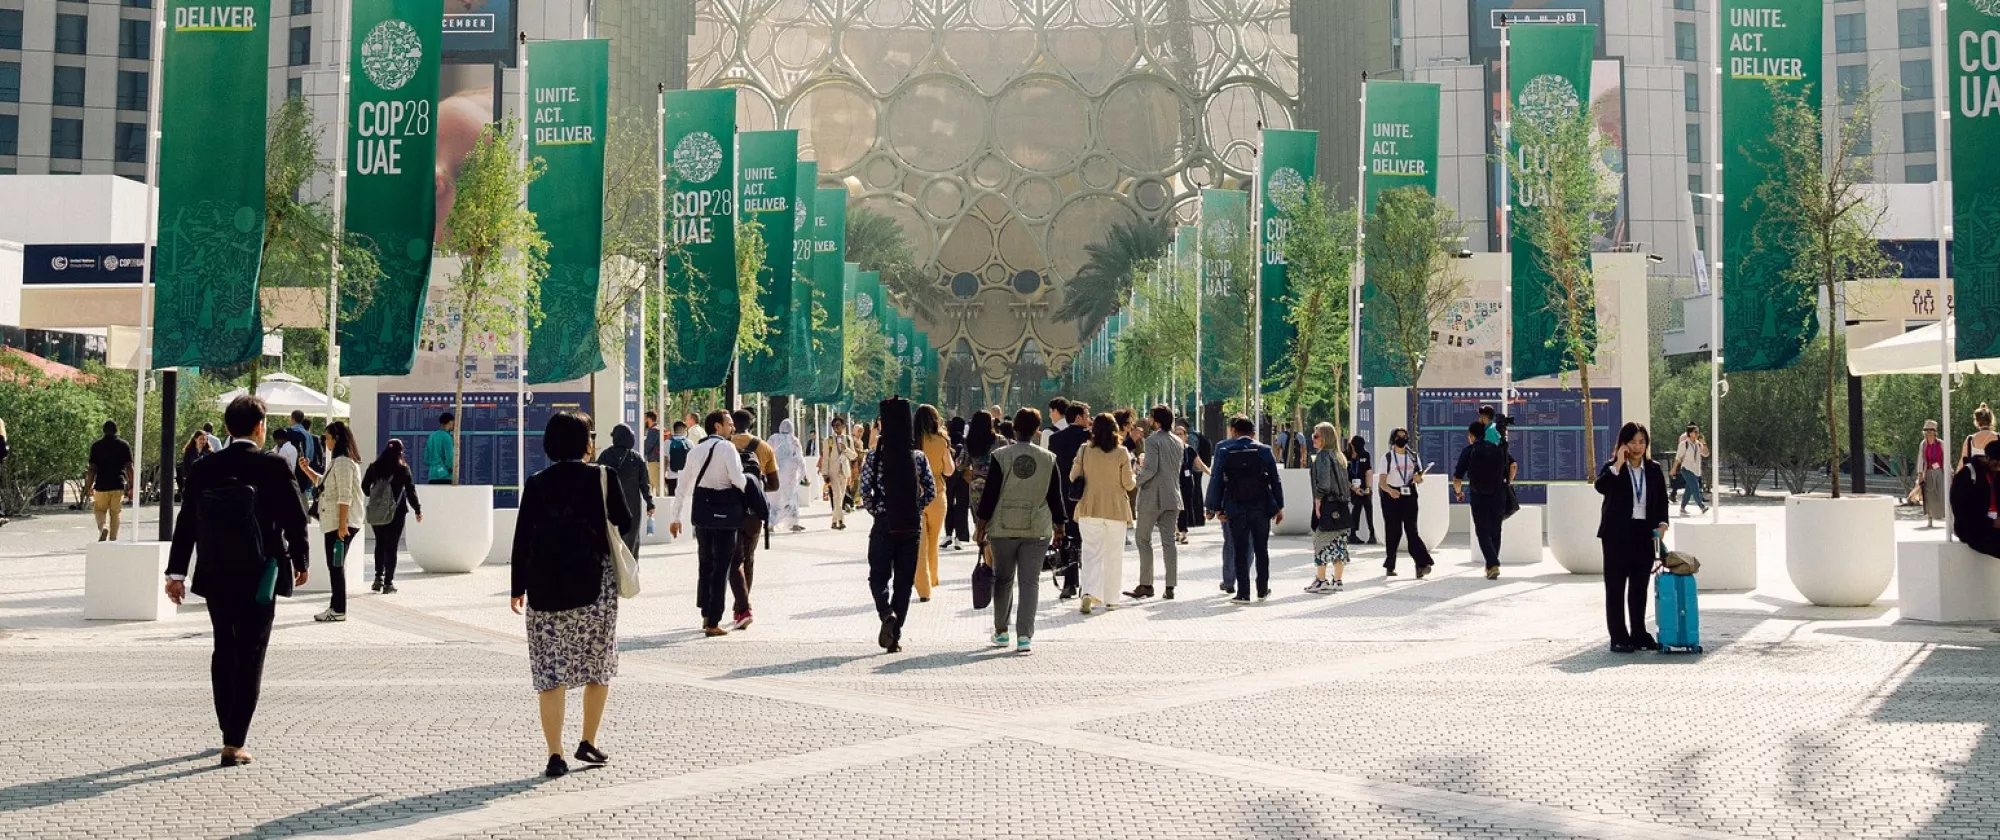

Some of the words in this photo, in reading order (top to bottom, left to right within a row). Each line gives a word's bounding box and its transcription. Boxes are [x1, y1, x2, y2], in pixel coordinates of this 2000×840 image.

[175, 7, 257, 27] DELIVER.
[1730, 8, 1786, 27] UNITE.
[1730, 33, 1767, 51] ACT.
[1731, 57, 1807, 76] DELIVER.
[535, 87, 580, 103] UNITE.
[1960, 75, 2000, 117] UA
[358, 99, 429, 137] COP28
[534, 107, 565, 123] ACT.
[536, 126, 595, 142] DELIVER.
[1373, 123, 1413, 138] UNITE.
[1372, 141, 1398, 155] ACT.
[357, 140, 401, 175] UAE
[745, 167, 777, 180] UNITE.
[1373, 159, 1428, 174] DELIVER.
[744, 184, 765, 195] ACT.
[673, 189, 732, 217] COP28
[744, 197, 788, 211] DELIVER.
[673, 218, 712, 245] UAE
